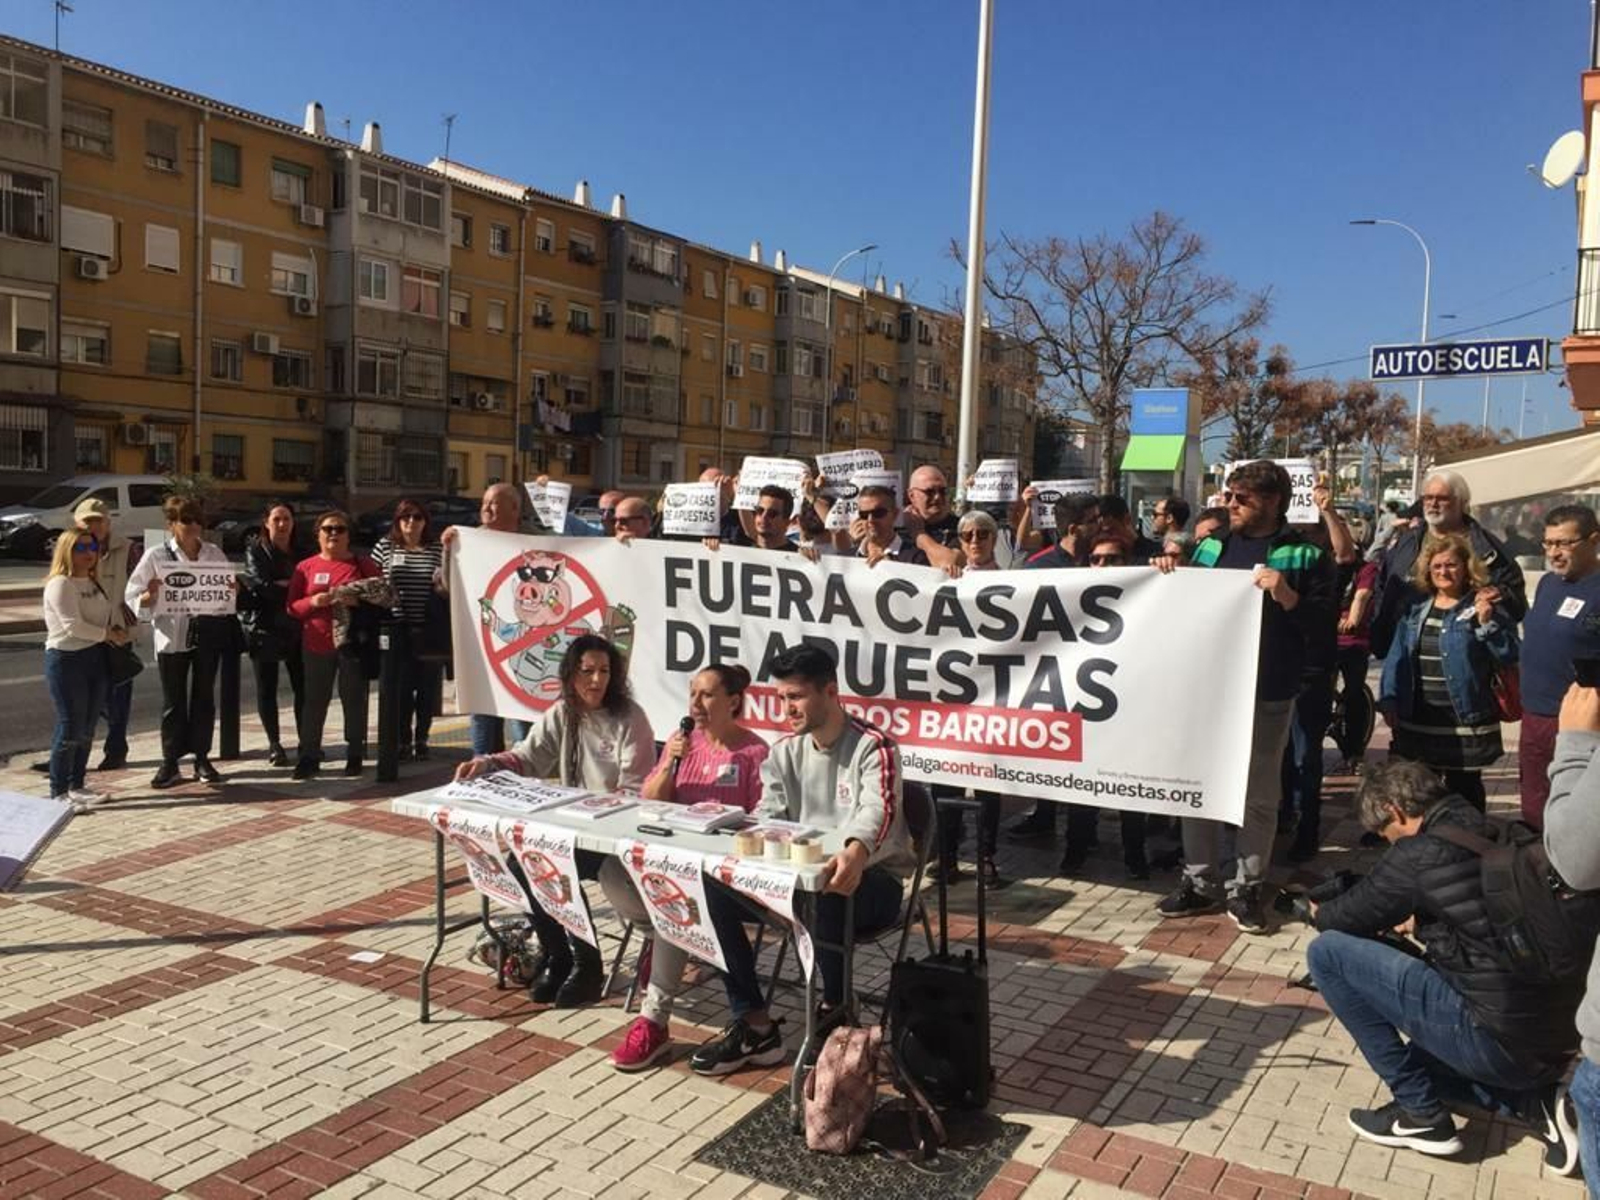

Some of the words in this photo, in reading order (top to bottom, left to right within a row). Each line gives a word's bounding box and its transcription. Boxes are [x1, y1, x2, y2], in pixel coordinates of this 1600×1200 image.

[1374, 345, 1541, 375] AUTOESCUELA
[1291, 474, 1313, 488] SAS
[165, 589, 179, 602] DE
[181, 589, 231, 602] APUESTAS
[169, 575, 194, 585] STOP
[200, 574, 232, 586] CASAS
[664, 556, 864, 628] FUERA
[876, 577, 1125, 645] CASAS
[665, 619, 741, 672] DE
[918, 709, 1073, 751] BARRIOS
[900, 752, 1203, 808] alagacontralascasasdeapuestas.org
